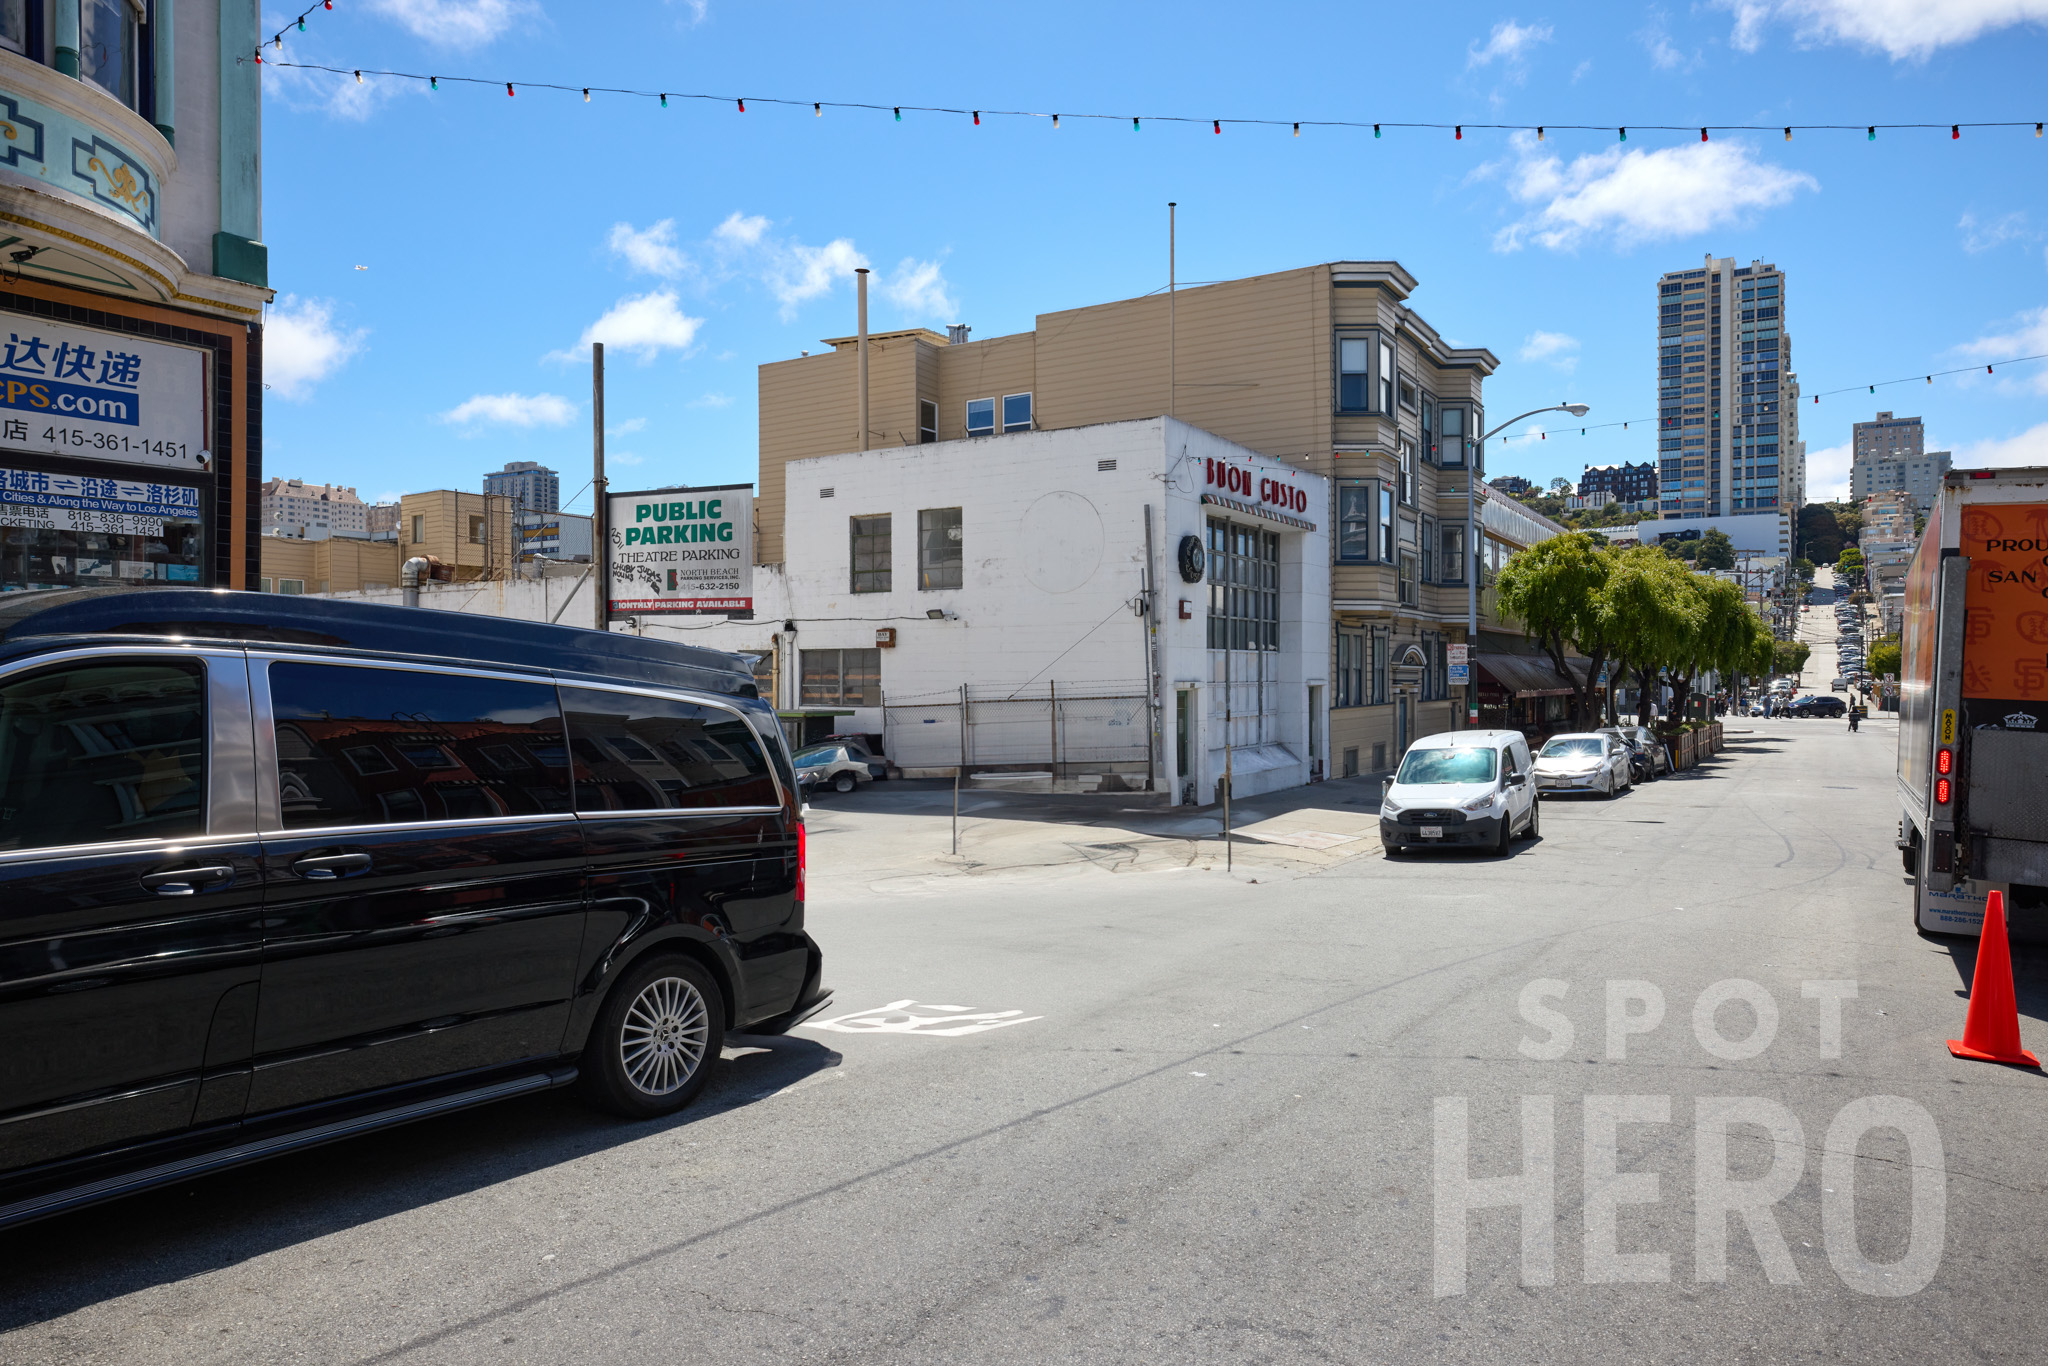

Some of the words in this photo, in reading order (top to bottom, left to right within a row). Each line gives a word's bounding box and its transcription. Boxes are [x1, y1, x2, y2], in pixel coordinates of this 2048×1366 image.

[0, 333, 142, 389] 达快递
[0, 380, 127, 419] PS.com
[3, 419, 28, 441] 店
[42, 427, 187, 459] 415-361-1451
[81, 477, 118, 498] 沿途
[146, 484, 198, 506] 洛杉矶
[1207, 458, 1251, 496] BUON
[1261, 478, 1307, 512] GUSTO
[3, 491, 35, 503] Cities
[37, 494, 46, 504] &
[48, 496, 80, 508] Along
[82, 498, 99, 508] the
[100, 500, 125, 511] Way
[126, 501, 136, 511] to
[138, 503, 157, 513] Los
[158, 505, 198, 516] Angeles
[636, 500, 722, 523] PUBLIC
[67, 510, 164, 527] 818-836-9990
[70, 521, 161, 537] 415-361-1451
[625, 522, 733, 546] PARKING
[618, 551, 678, 563] THEATRE
[682, 548, 740, 561] PARKING
[1986, 539, 2048, 552] PROU
[710, 567, 739, 575] BEACH
[1988, 570, 2037, 583] SAN
[680, 582, 740, 591] 415-632-2150
[696, 600, 746, 608] AVAILABLE
[1944, 713, 1953, 740] MAXON
